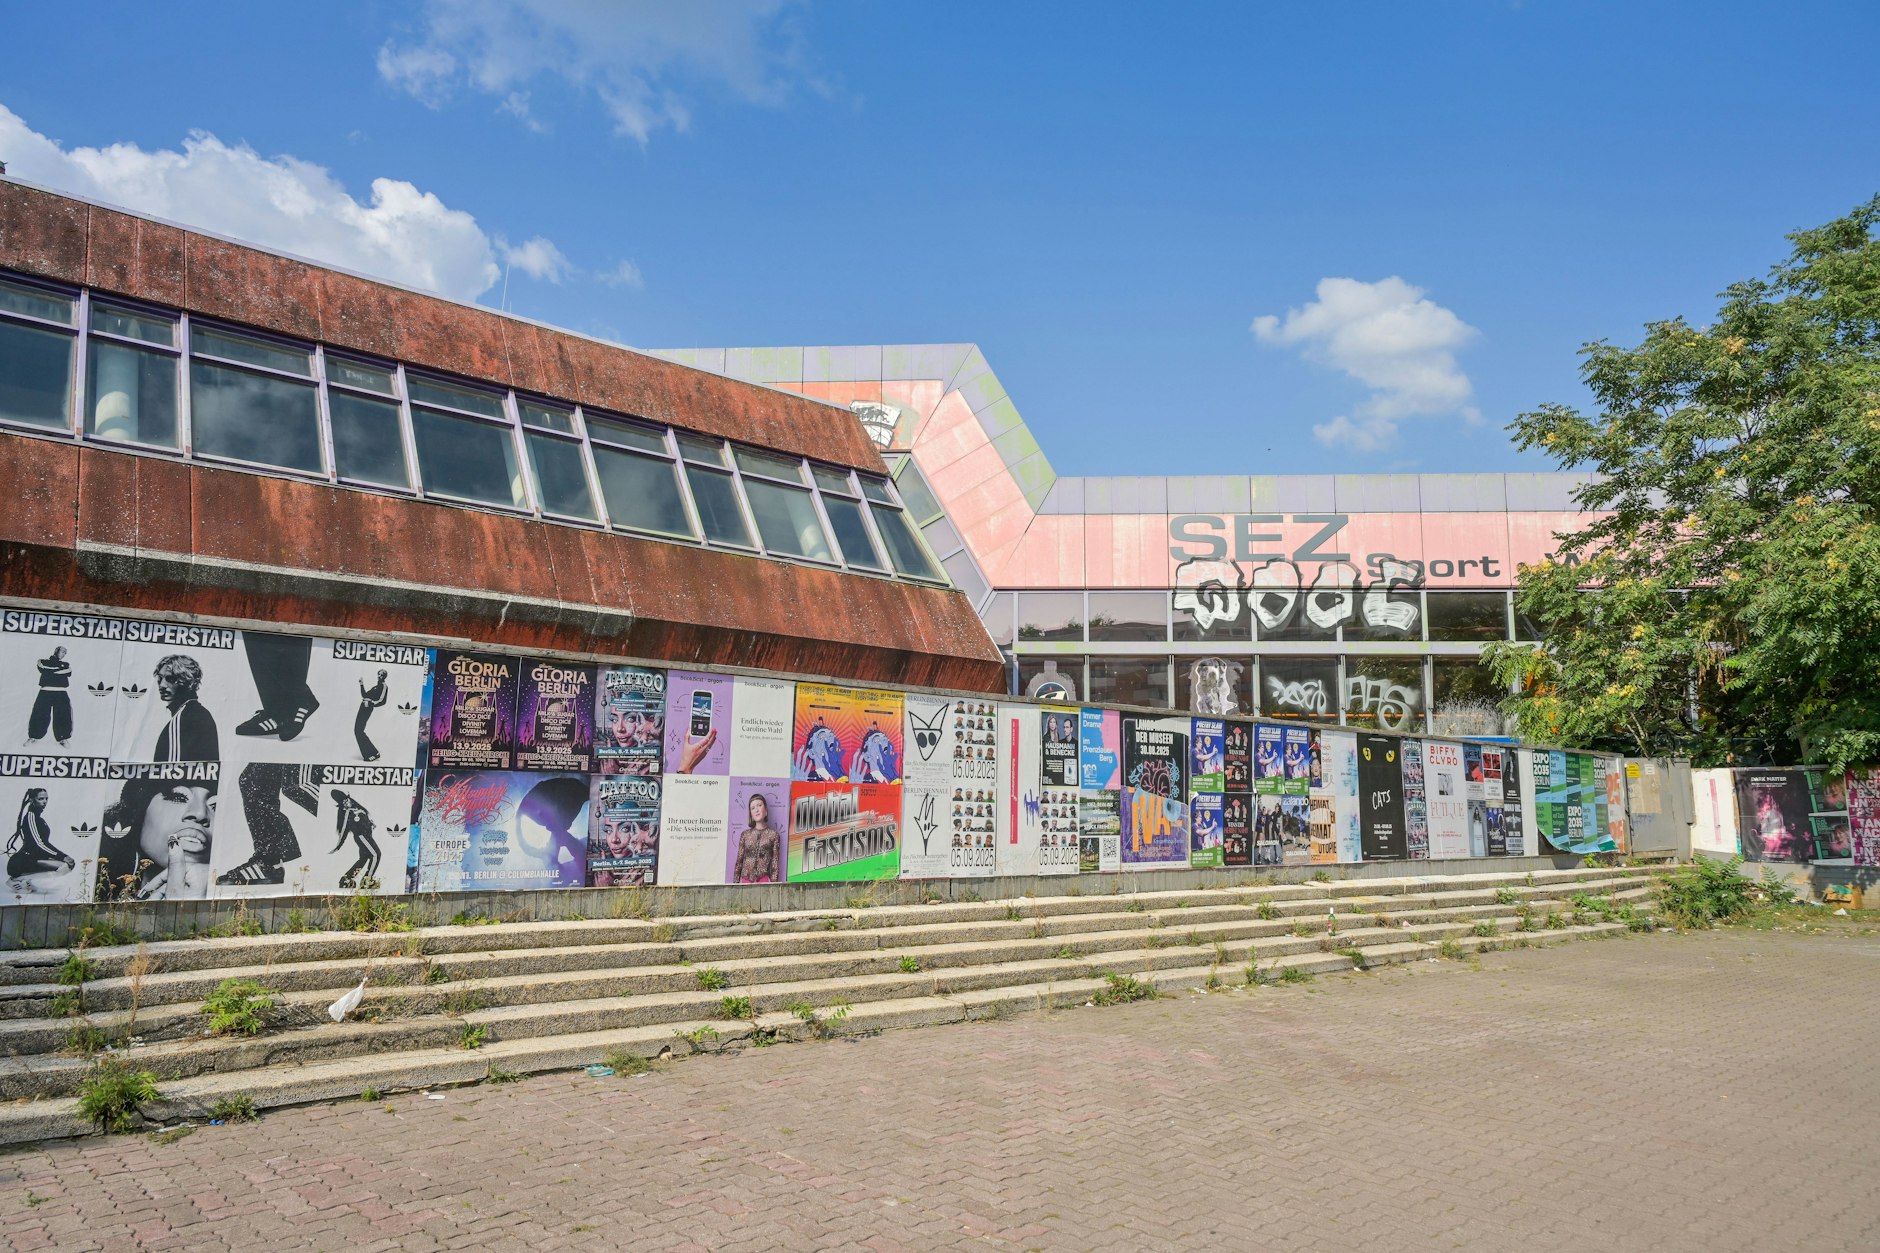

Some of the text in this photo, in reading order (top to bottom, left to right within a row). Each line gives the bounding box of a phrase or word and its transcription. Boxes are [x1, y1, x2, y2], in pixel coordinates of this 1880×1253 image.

[1170, 515, 1350, 562] SEZ
[5, 611, 123, 640] SUPERSTAR
[127, 621, 233, 649] SUPERSTAR
[334, 641, 424, 665] SUPERSTAR
[448, 660, 509, 678] GLORIA
[531, 668, 588, 684] GLORIA
[606, 671, 664, 692] TATTOO
[455, 675, 501, 689] BERLIN
[537, 682, 580, 694] BERLIN
[1083, 712, 1101, 720] Immer
[741, 717, 784, 727] Endlich wieder
[1083, 720, 1101, 728] Drama
[1196, 720, 1212, 729] POETRY
[741, 725, 766, 733] Caroline
[1258, 726, 1281, 735] POETRY SLAM
[1136, 731, 1173, 744] DER MUSEEN
[453, 742, 492, 751] 13.9.2025
[536, 746, 572, 754] 13.9.2025
[1045, 742, 1076, 750] HAUSMANN
[1083, 745, 1113, 753] Prenzlauer
[1140, 745, 1170, 756] 30.08.2025
[1430, 745, 1456, 755] BIFFY
[1099, 754, 1113, 763] Berg
[1429, 755, 1458, 766] CLYRO
[1533, 753, 1549, 764] EXPO
[1593, 758, 1605, 766] EXPO
[0, 754, 105, 779] UPERSTAR
[110, 762, 219, 781] SUPERSTAR
[952, 759, 996, 779] 05.09.2025
[1533, 764, 1550, 775] 2035
[321, 765, 413, 786] SUPERSTAR
[1594, 769, 1605, 778] 2035
[1535, 775, 1550, 786] BERLIN
[1594, 779, 1606, 789] BERLIN
[599, 781, 659, 800] TATTOO
[1196, 795, 1222, 803] POETRY SLAM
[1283, 796, 1309, 806] zalando
[1372, 789, 1391, 810] CATS
[794, 786, 859, 834] Global
[1310, 799, 1329, 811] HEIMAT
[1567, 806, 1582, 816] EXPO
[668, 817, 679, 825] Ihr
[699, 817, 722, 825] Roman
[1568, 817, 1583, 828] 2035
[1310, 823, 1331, 839] HEIMAT
[1569, 829, 1583, 838] BERLIN
[435, 840, 467, 849] EUROPE
[802, 822, 897, 874] Fascisms
[1318, 841, 1337, 854] UTOPIE
[951, 848, 994, 867] 05.09.2025
[1039, 847, 1079, 866] 05.09.2025
[474, 870, 497, 880] BERLIN
[507, 869, 560, 879] COLUMBIAHALLE
